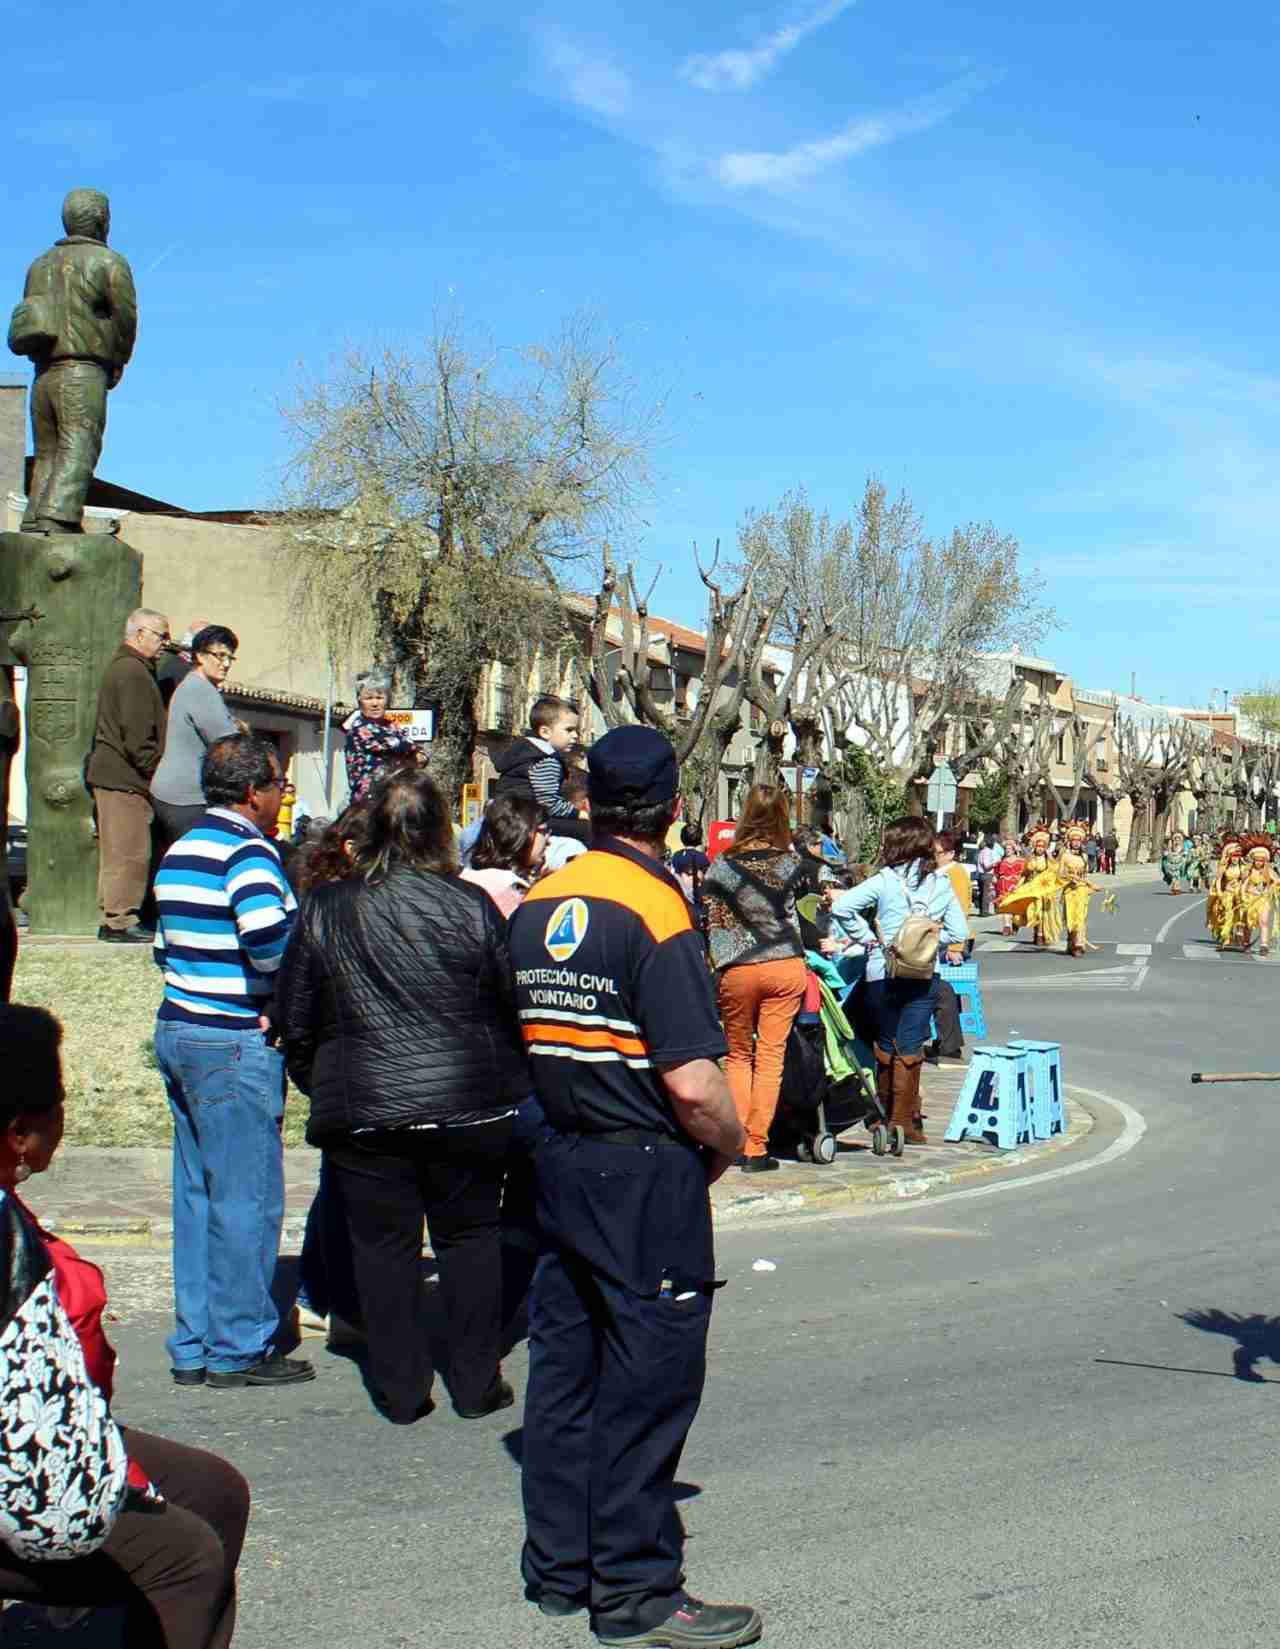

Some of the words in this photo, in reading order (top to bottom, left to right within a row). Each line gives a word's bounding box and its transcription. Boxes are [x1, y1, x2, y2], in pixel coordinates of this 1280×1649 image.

[516, 968, 577, 987] PROTECCIÓN
[580, 974, 618, 995] CIVIL
[529, 989, 597, 1010] VONTARIO
